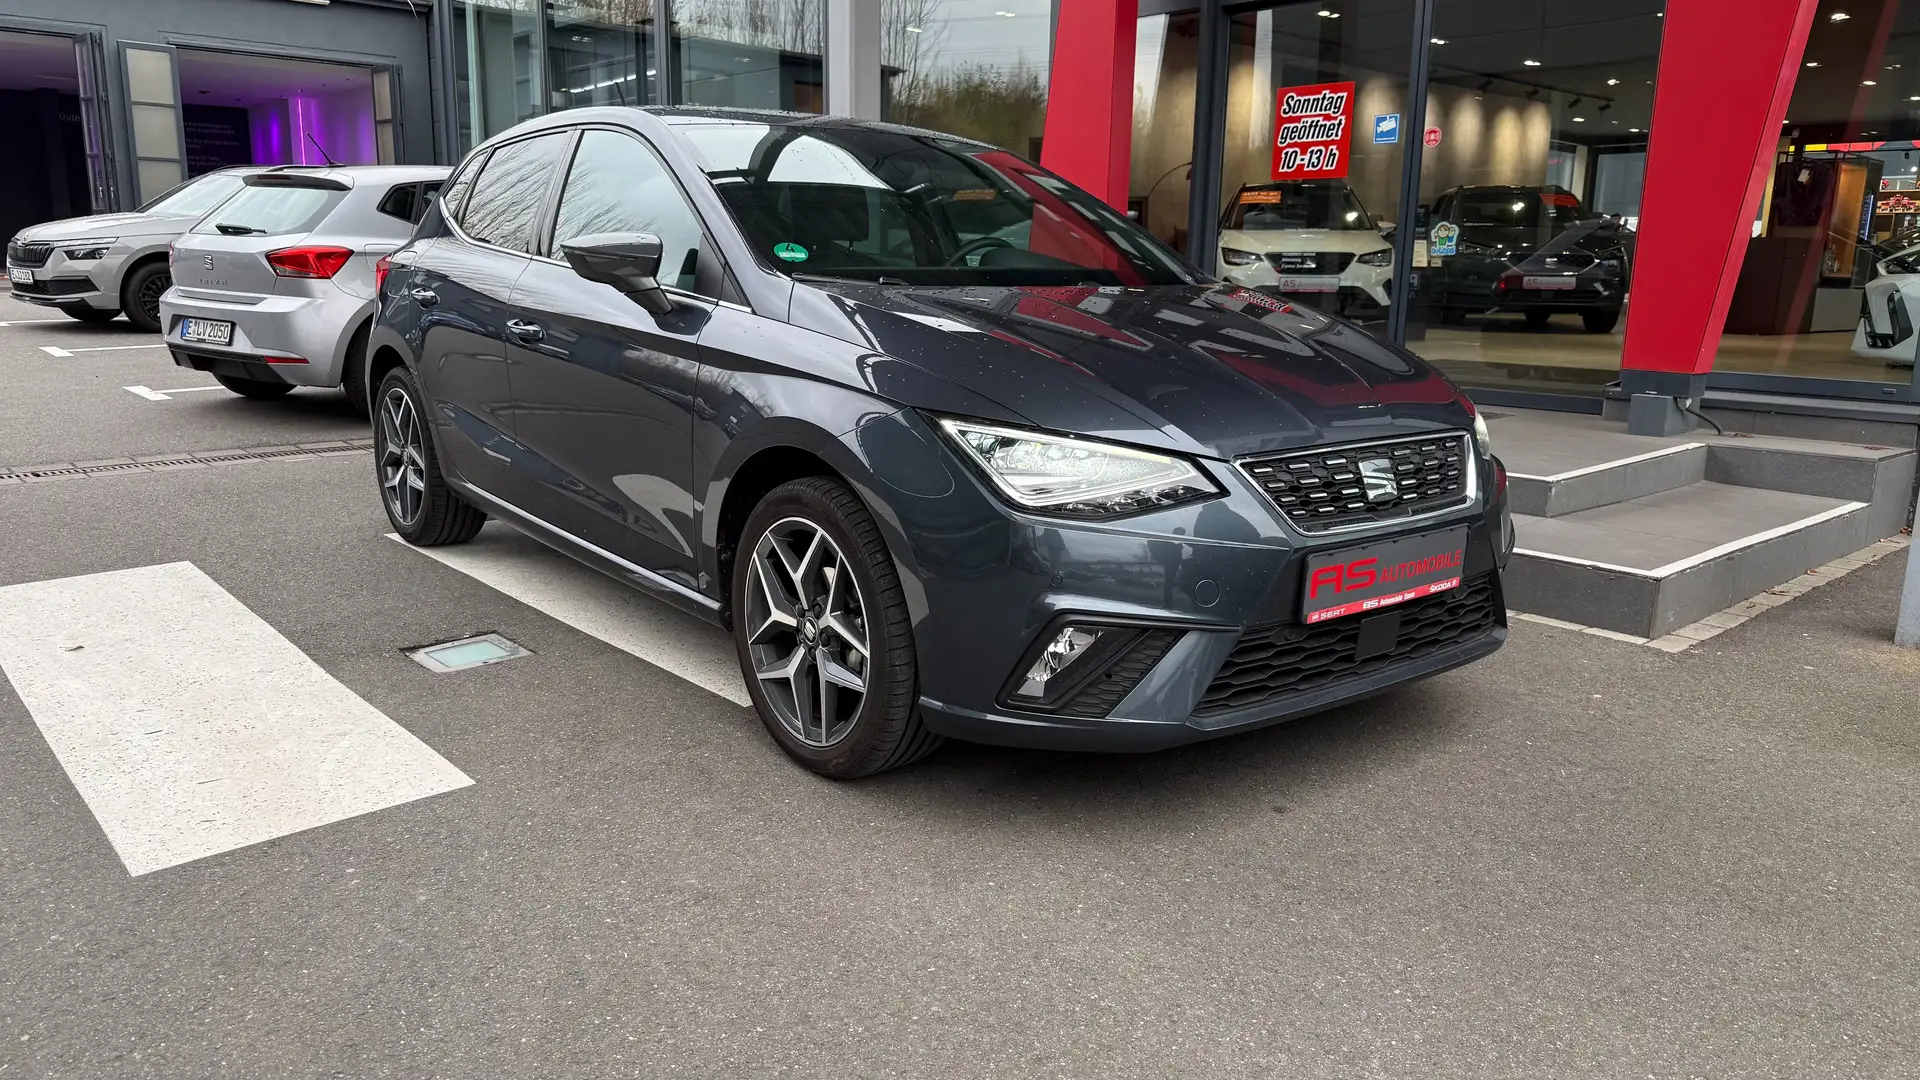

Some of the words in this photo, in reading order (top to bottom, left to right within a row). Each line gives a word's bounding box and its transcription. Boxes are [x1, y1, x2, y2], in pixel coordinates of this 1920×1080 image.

[1281, 91, 1347, 117] Sonntag
[1278, 117, 1345, 146] geöffnet
[1324, 146, 1338, 170] h
[785, 243, 796, 252] 4
[1283, 280, 1296, 288] AS
[187, 320, 193, 335] E
[196, 321, 208, 336] LV
[208, 322, 229, 339] 2050
[1309, 556, 1379, 599] AS
[1378, 549, 1463, 585] AUTOMOBILE
[1320, 608, 1346, 619] SEAT
[1429, 582, 1452, 593] ŠKODA
